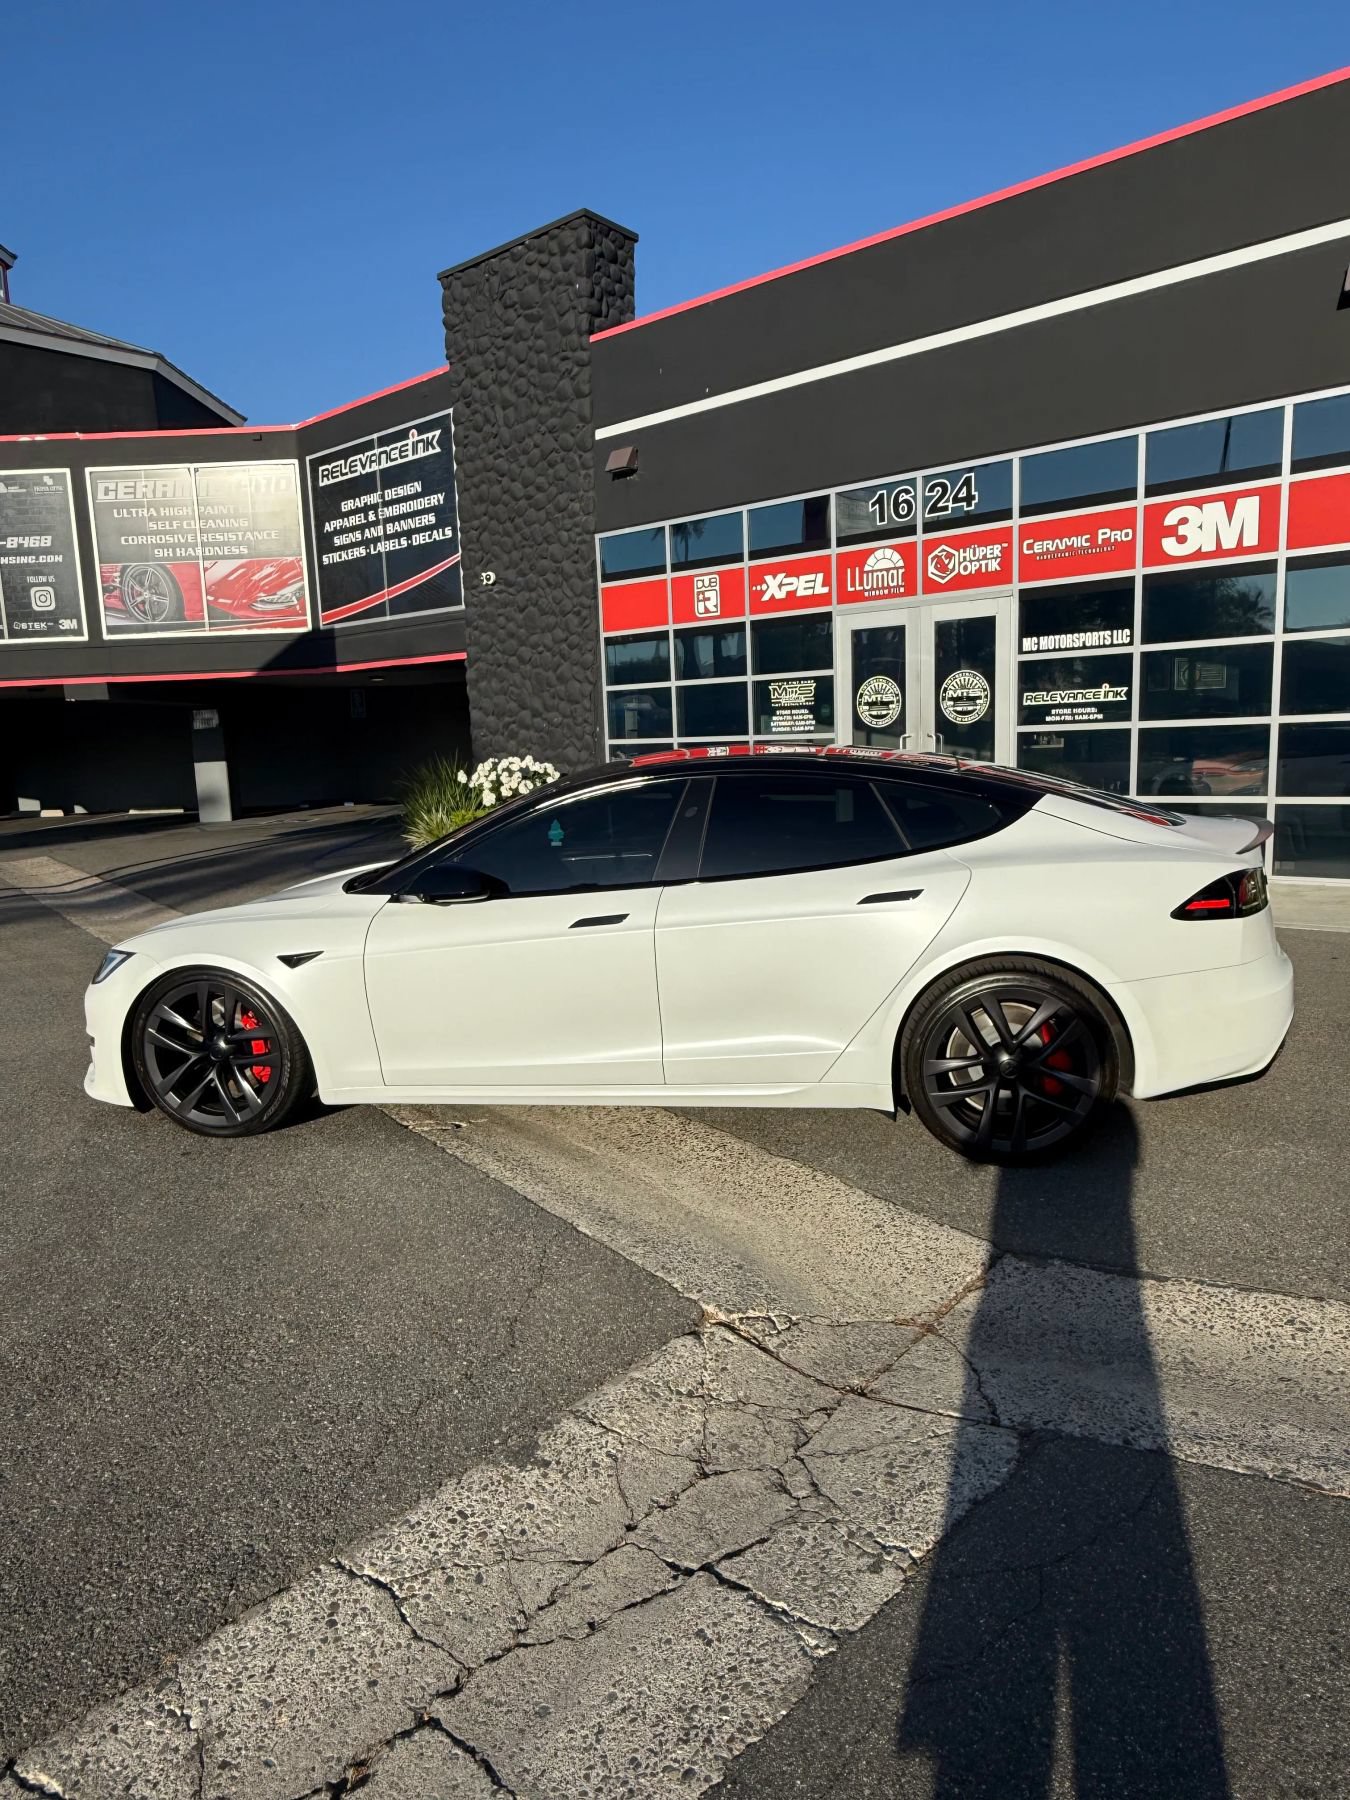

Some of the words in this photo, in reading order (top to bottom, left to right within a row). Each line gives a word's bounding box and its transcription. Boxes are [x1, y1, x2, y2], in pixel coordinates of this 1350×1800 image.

[341, 491, 383, 512] GRAPHIC
[384, 481, 422, 501] DESIGN
[112, 507, 157, 518] ULTRA
[160, 506, 191, 516] HIGH
[198, 504, 234, 515] PAINT
[324, 513, 367, 533] APPAREL
[368, 510, 377, 522] &
[378, 492, 445, 519] EMBROIDERY
[149, 519, 181, 531] SELF
[182, 518, 249, 529] CLEANING
[333, 530, 362, 546] SIGNS
[363, 525, 384, 540] AND
[386, 513, 436, 534] BANNERS
[1161, 495, 1260, 557] 3M
[121, 533, 197, 545] CORROSIVE
[200, 530, 279, 542] RESISTANCE
[322, 545, 367, 565] STICKERS
[370, 537, 408, 554] LABELS
[412, 527, 453, 546] DECALS
[1023, 534, 1091, 555] CERAMIC
[154, 548, 174, 558] 9H
[176, 546, 249, 557] HARDNESS
[960, 558, 1002, 576] OPTIK
[696, 577, 718, 590] DUB
[761, 572, 829, 601] XPEL
[59, 619, 78, 630] 3M
[1022, 636, 1039, 651] MC
[1038, 630, 1112, 651] MOTORSPORTS
[1112, 629, 1131, 645] LLC
